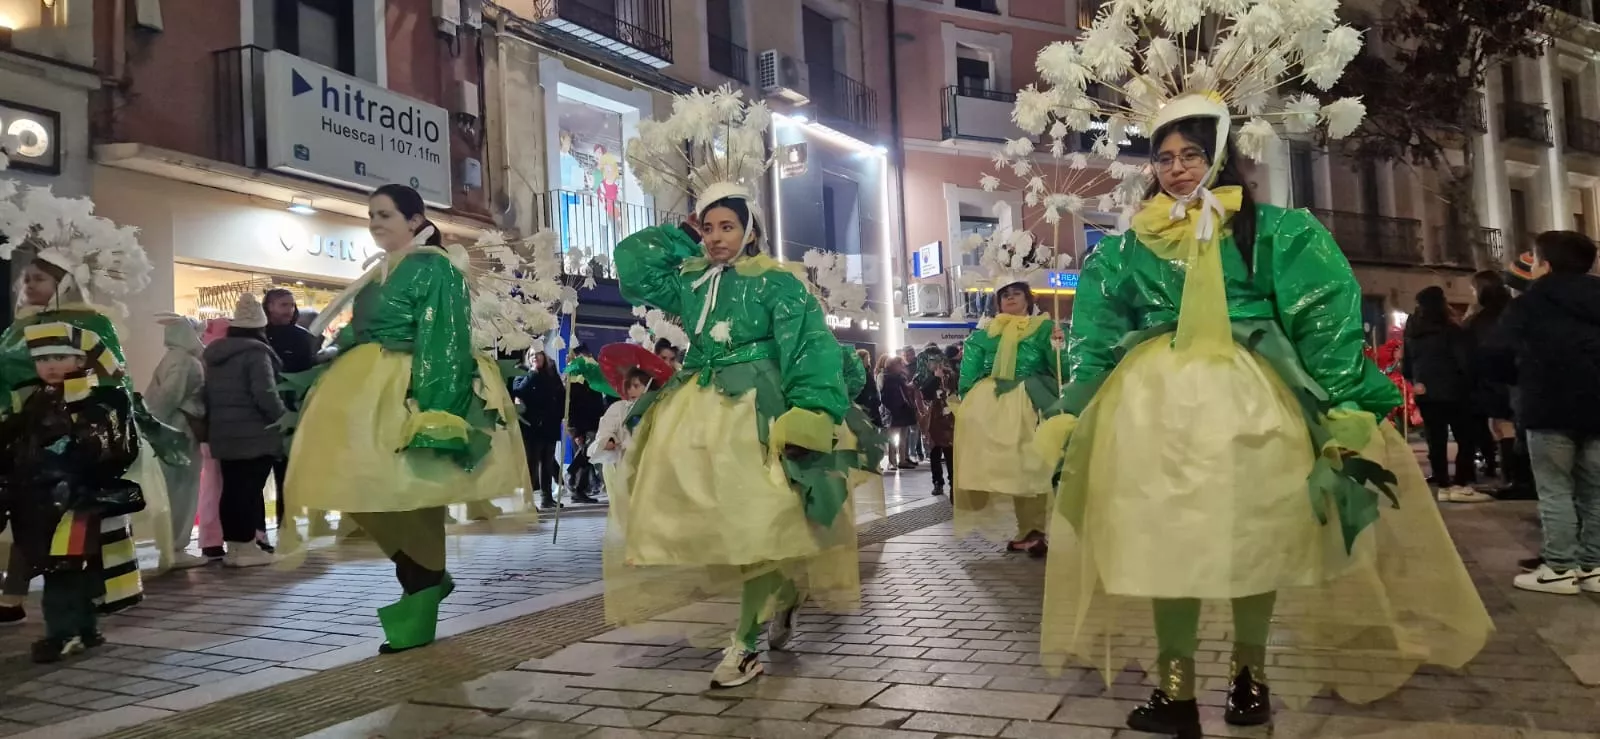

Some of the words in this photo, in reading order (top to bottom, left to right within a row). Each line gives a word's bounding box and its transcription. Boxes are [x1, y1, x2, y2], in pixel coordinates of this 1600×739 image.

[321, 76, 439, 143] hitradio
[321, 115, 376, 145] Huesca
[390, 137, 440, 164] 107.1fm
